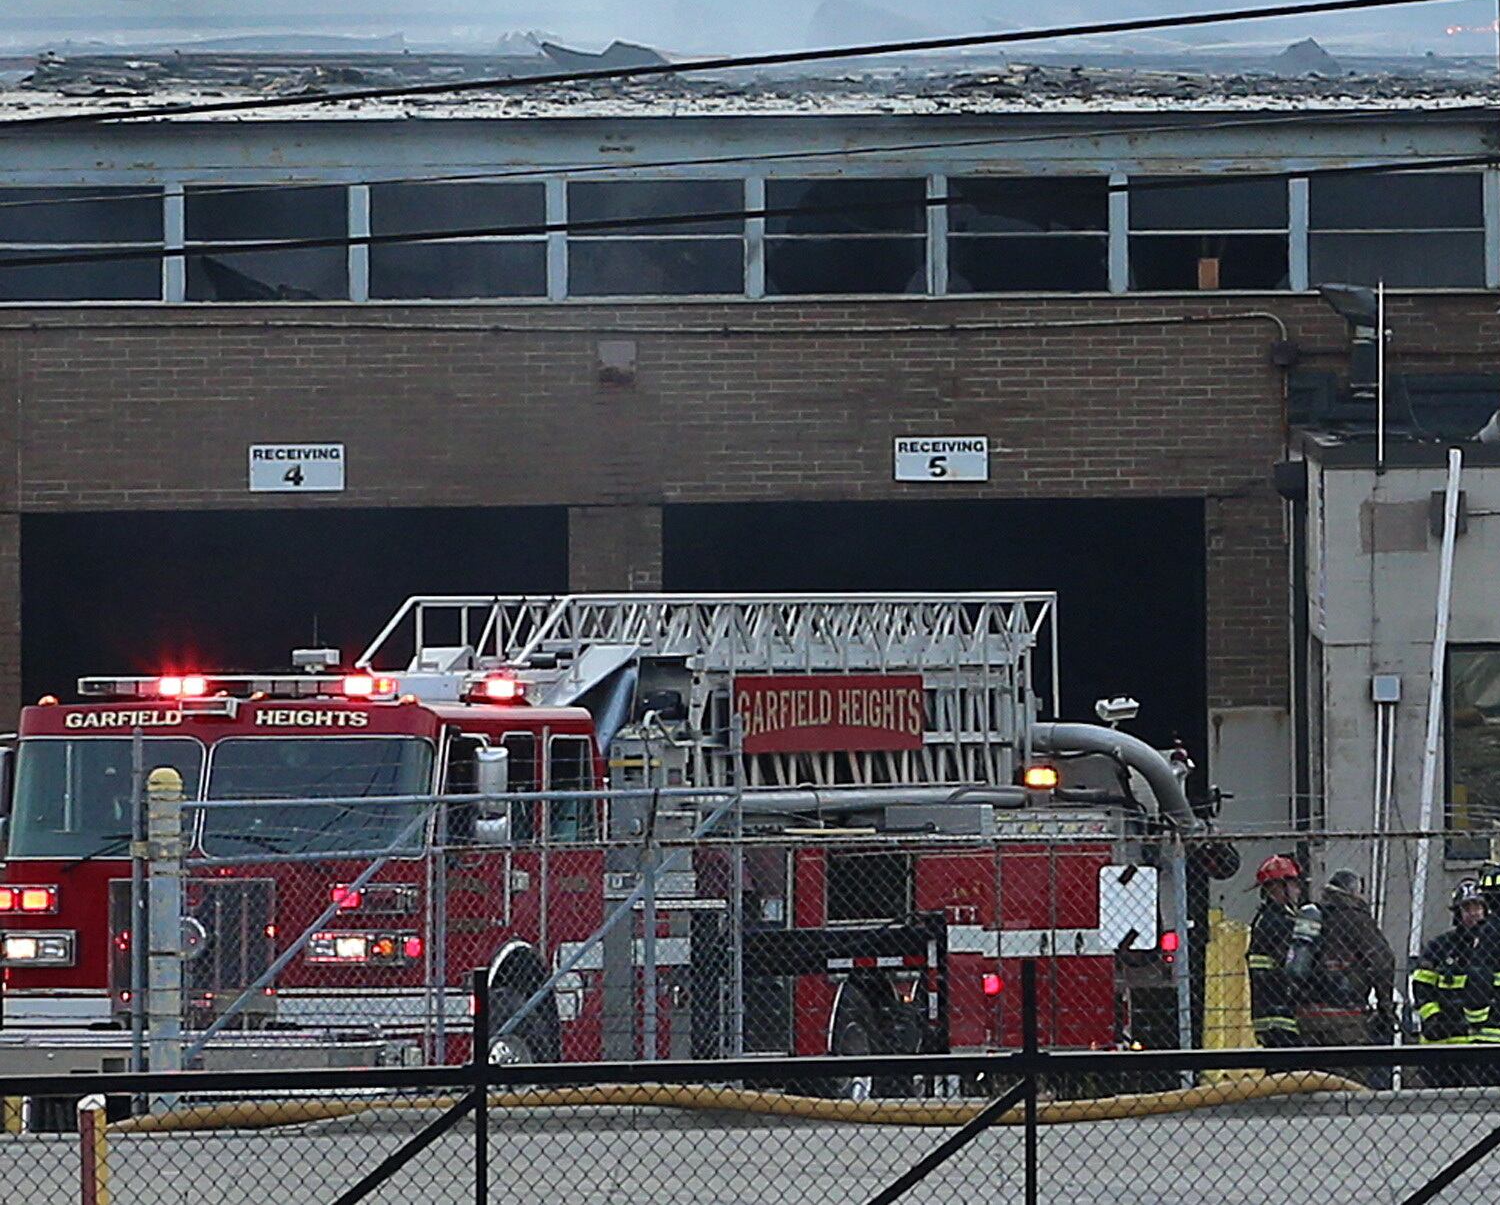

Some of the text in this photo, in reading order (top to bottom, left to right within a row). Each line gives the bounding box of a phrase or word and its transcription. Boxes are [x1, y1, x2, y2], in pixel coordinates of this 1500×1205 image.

[252, 447, 340, 460] RECEIVING
[898, 440, 985, 453] RECEIVING
[283, 463, 304, 486] 4
[928, 455, 947, 478] 5
[64, 709, 369, 728] GARFIELD HEIGHTS
[737, 688, 921, 738] GARFIELD HEIGHTS
